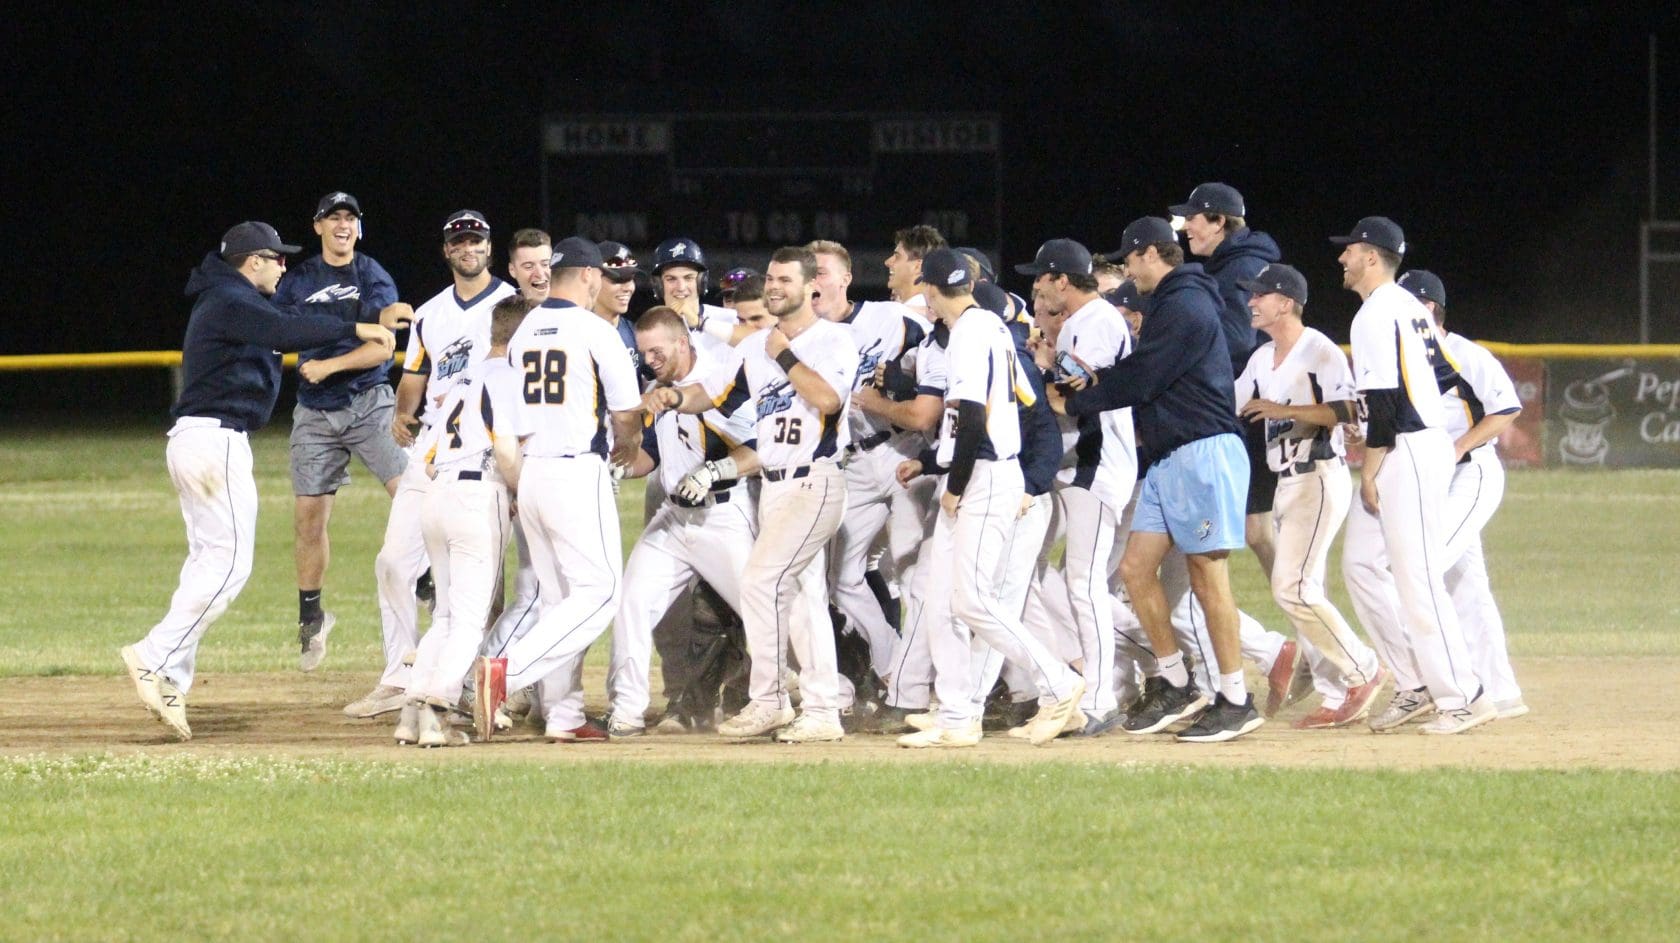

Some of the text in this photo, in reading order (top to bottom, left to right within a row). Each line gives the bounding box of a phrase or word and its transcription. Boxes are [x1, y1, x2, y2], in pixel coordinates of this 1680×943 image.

[563, 124, 649, 151] HOME
[879, 122, 993, 150] VISITOR
[575, 212, 649, 241] DOWN
[724, 211, 759, 241] TO
[765, 211, 804, 241] GO
[522, 349, 567, 405] 28
[446, 398, 464, 449] 4
[774, 417, 802, 445] 36
